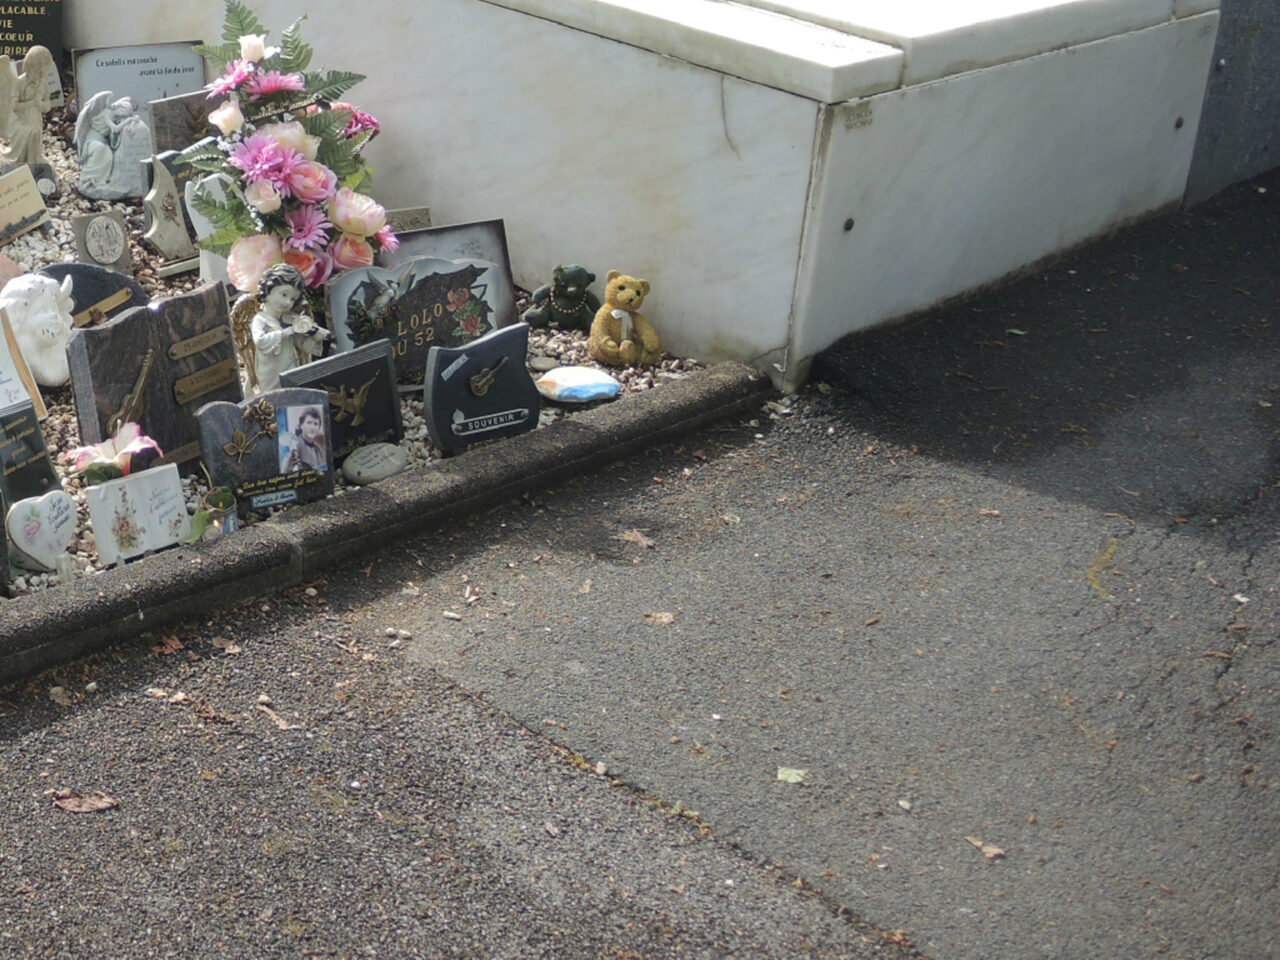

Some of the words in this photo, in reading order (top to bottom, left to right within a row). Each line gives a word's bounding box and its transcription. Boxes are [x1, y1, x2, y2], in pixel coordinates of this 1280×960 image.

[397, 303, 443, 337] LOLO
[415, 327, 435, 346] 52
[467, 413, 515, 430] SOUVENIR
